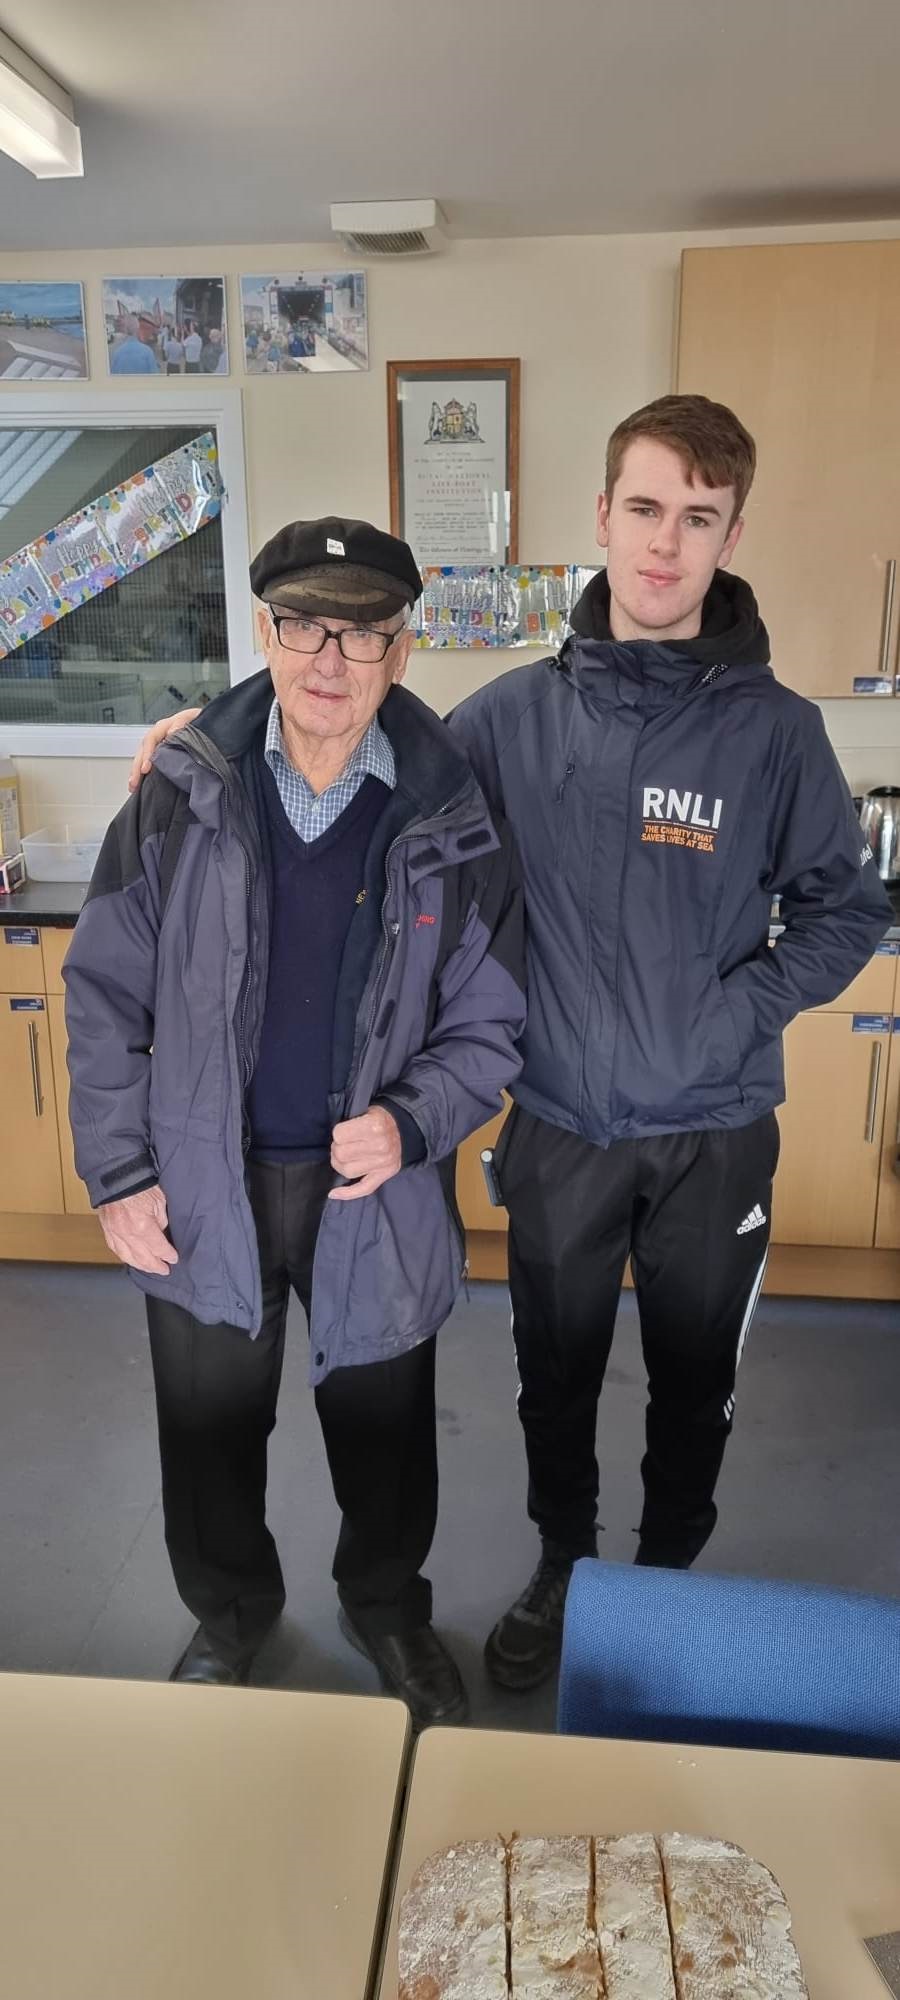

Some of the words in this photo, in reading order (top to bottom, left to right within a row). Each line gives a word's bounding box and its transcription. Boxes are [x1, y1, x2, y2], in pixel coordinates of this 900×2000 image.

[642, 787, 723, 829] RNLI
[641, 833, 666, 843] SAVES
[666, 835, 685, 845] LIVES
[686, 840, 696, 848] AT
[697, 842, 714, 852] SEA
[644, 825, 660, 833] THE
[661, 826, 692, 839] CHARITY
[693, 832, 714, 843] THAT
